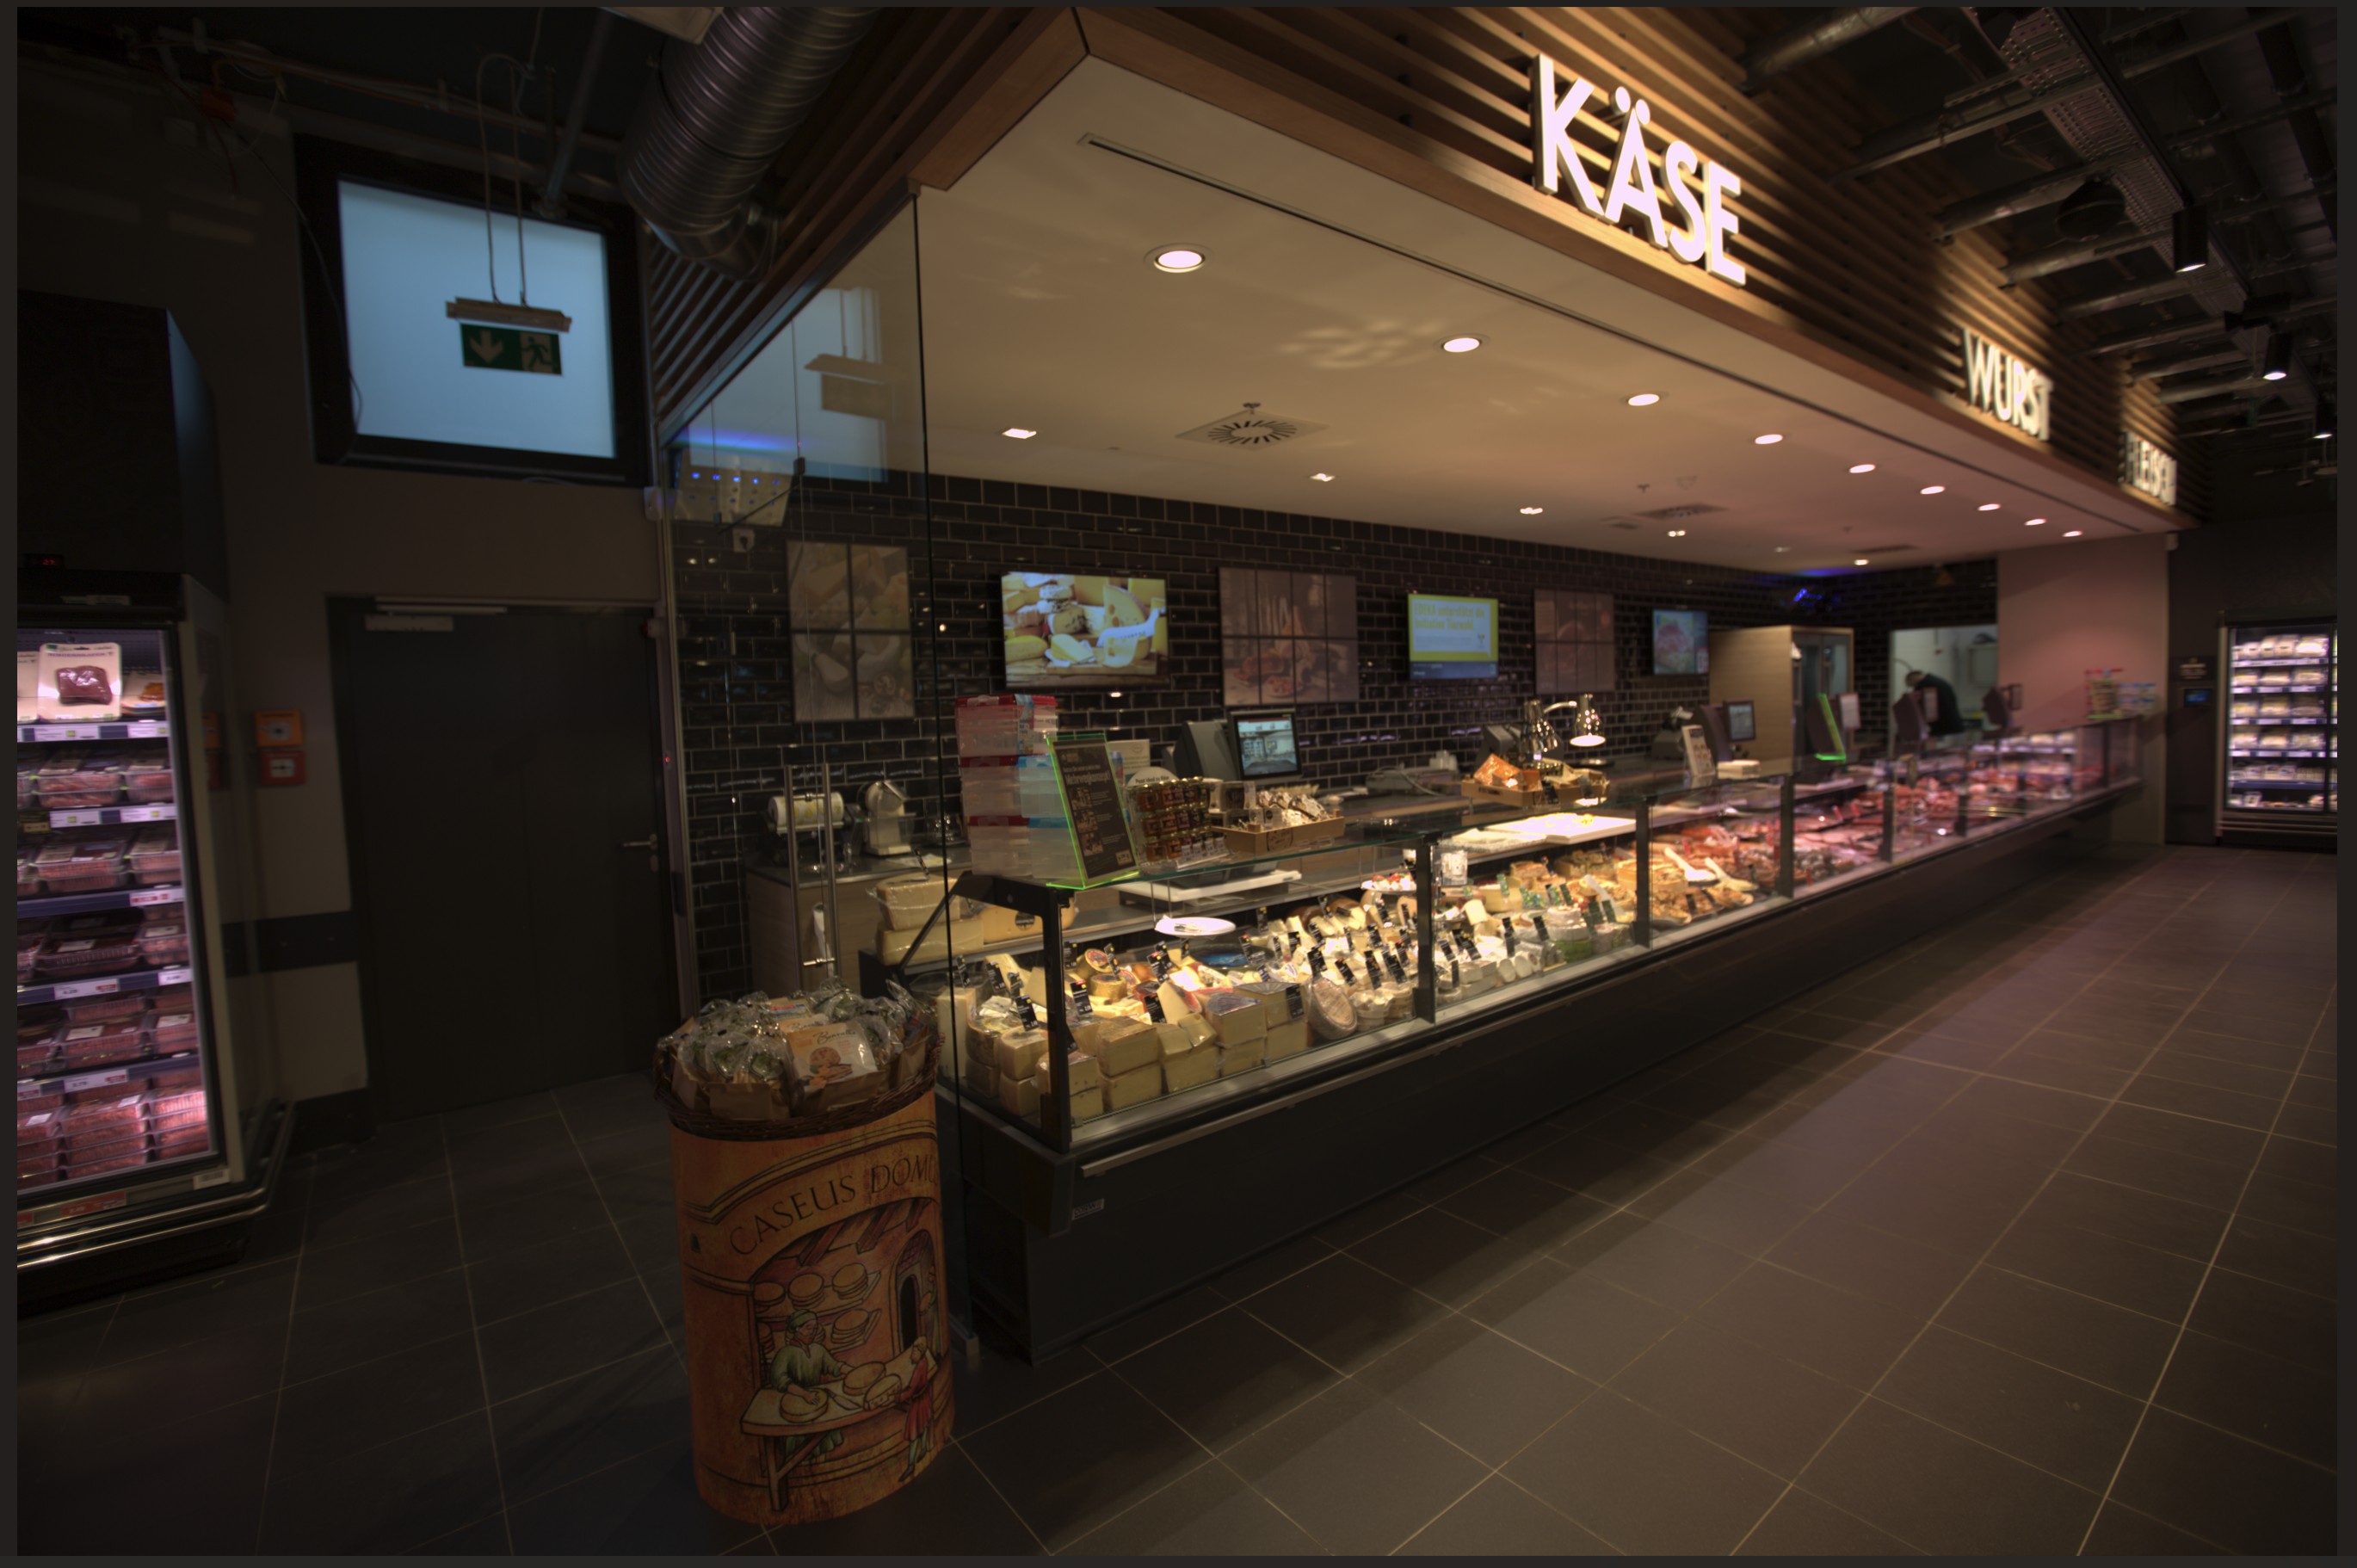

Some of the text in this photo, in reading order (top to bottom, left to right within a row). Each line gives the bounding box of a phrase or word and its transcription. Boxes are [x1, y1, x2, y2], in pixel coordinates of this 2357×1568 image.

[1535, 53, 1746, 286] KÄSE
[1963, 328, 2054, 441] WURST
[730, 1175, 856, 1256] CASEUS
